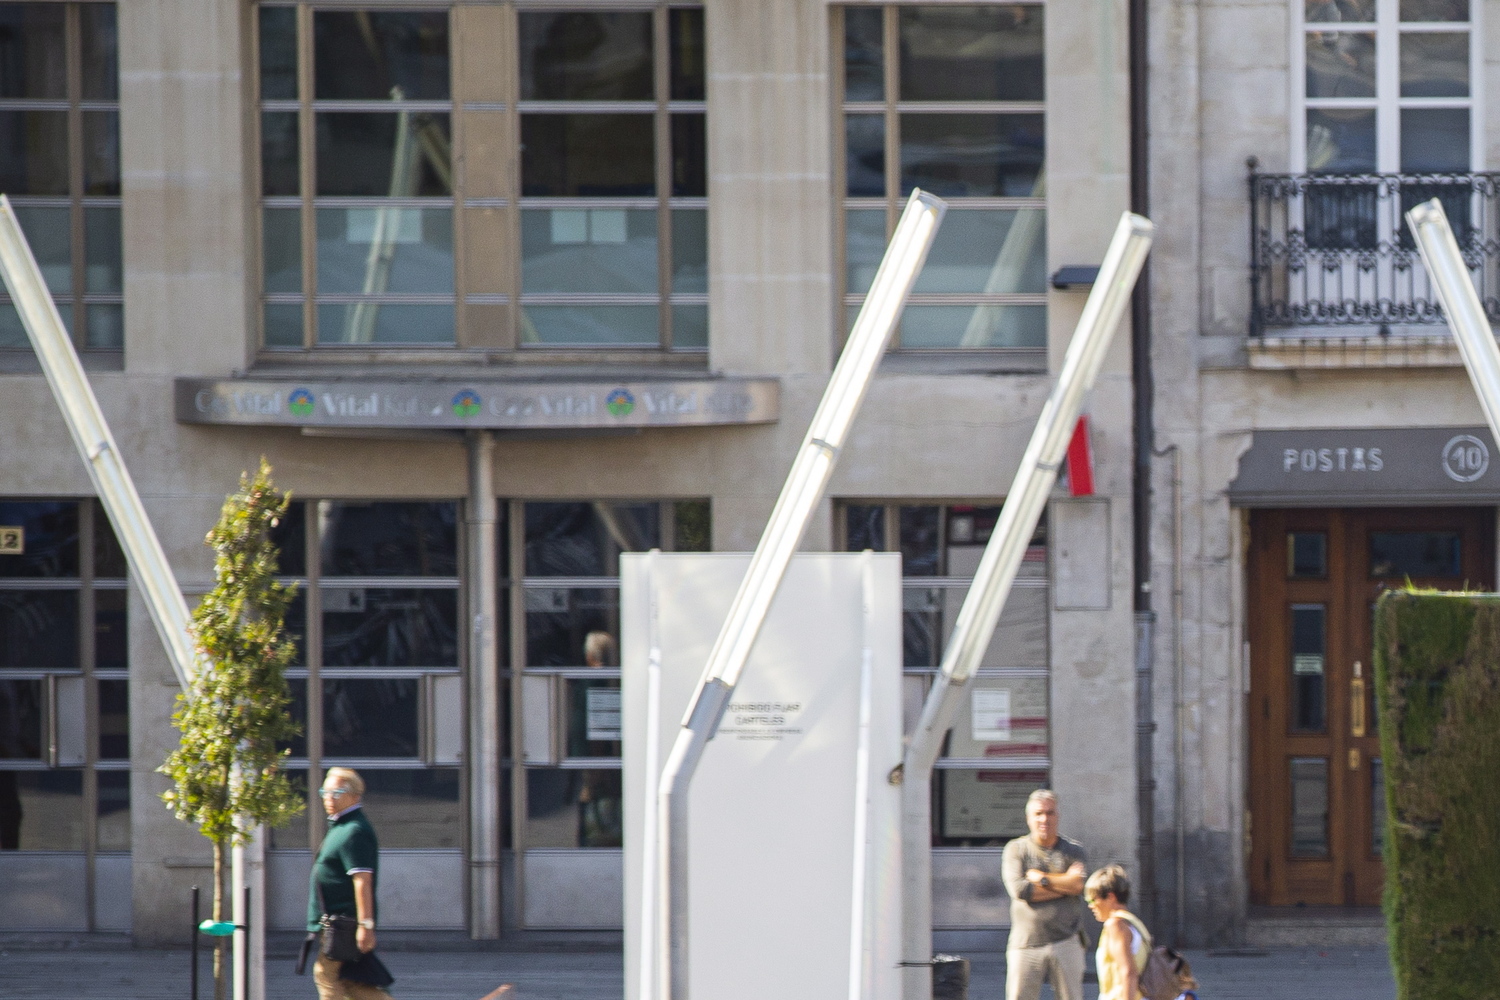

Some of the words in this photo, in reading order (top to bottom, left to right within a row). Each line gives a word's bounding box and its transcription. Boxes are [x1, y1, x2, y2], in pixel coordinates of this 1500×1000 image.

[322, 392, 379, 416] Vital
[643, 391, 697, 414] Vital
[1283, 447, 1384, 472] POSTAS
[1451, 446, 1483, 471] 10
